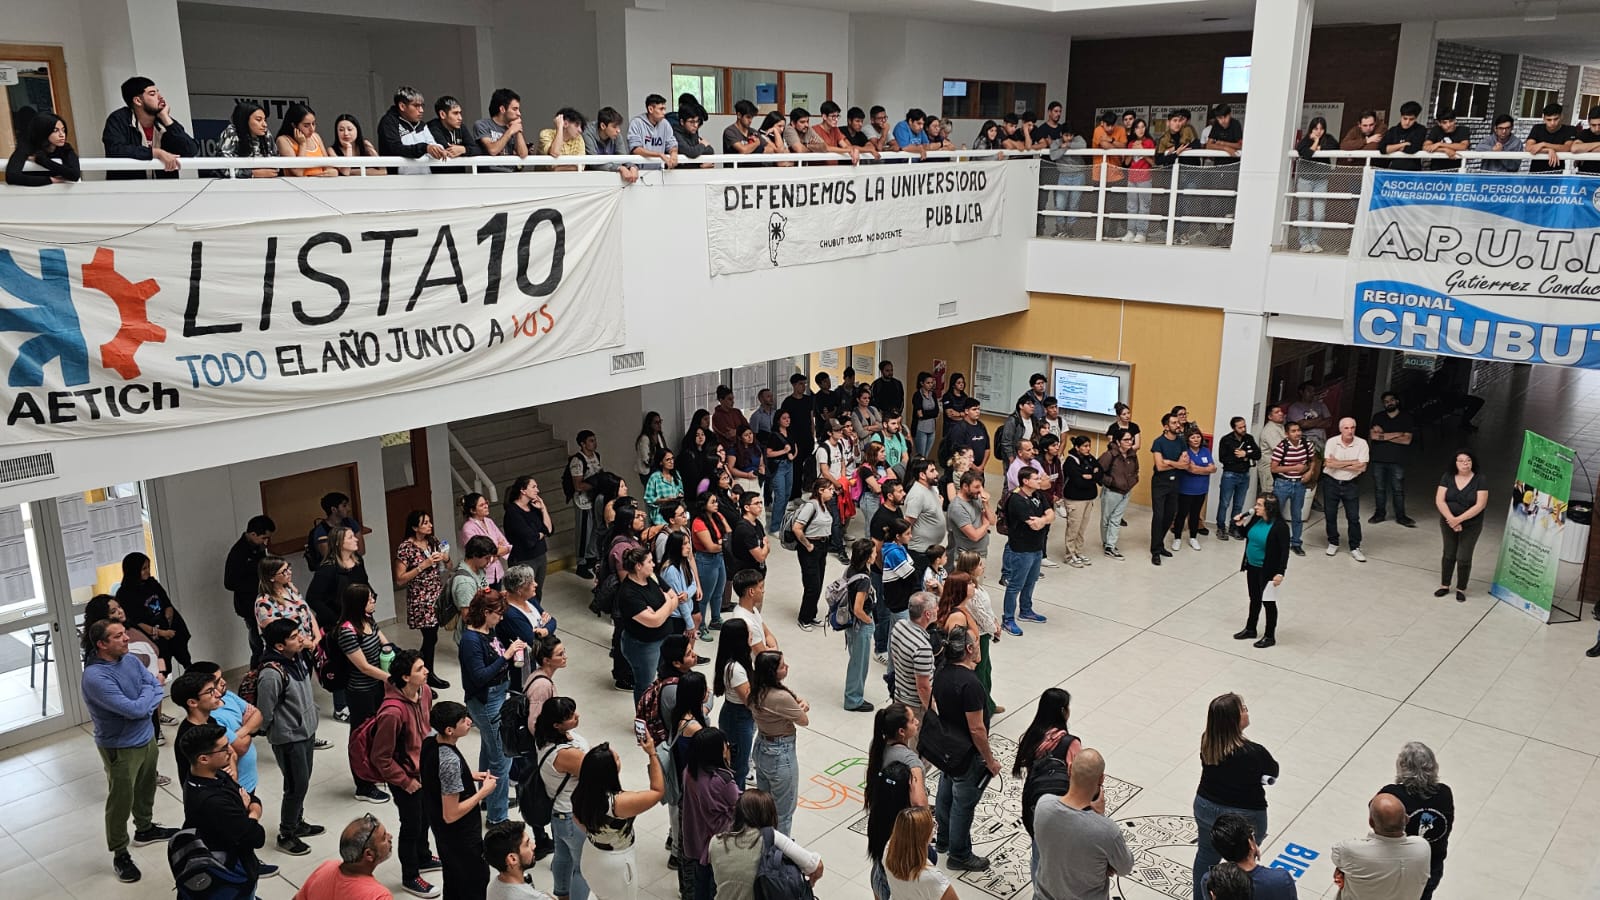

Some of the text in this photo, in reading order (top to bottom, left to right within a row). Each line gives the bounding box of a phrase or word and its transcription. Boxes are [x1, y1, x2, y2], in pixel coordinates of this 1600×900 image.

[723, 179, 857, 212] DEFENDEMOS
[865, 176, 885, 203] LA
[1380, 188, 1585, 206] UNIVERSIDAD TECNOLÓGICA NACIONAL
[1382, 180, 1588, 196] ASOCIACIÓN DEL PERSONAL DE LA
[926, 202, 983, 229] PUBLICA
[819, 237, 845, 248] CHUBUT
[847, 233, 863, 245] 100%
[1445, 269, 1531, 294] Gutierrez
[1363, 289, 1456, 312] REGIONAL
[176, 303, 555, 389] TODO EL AÑO JUNTO A VOS
[7, 381, 180, 426] AETICh
